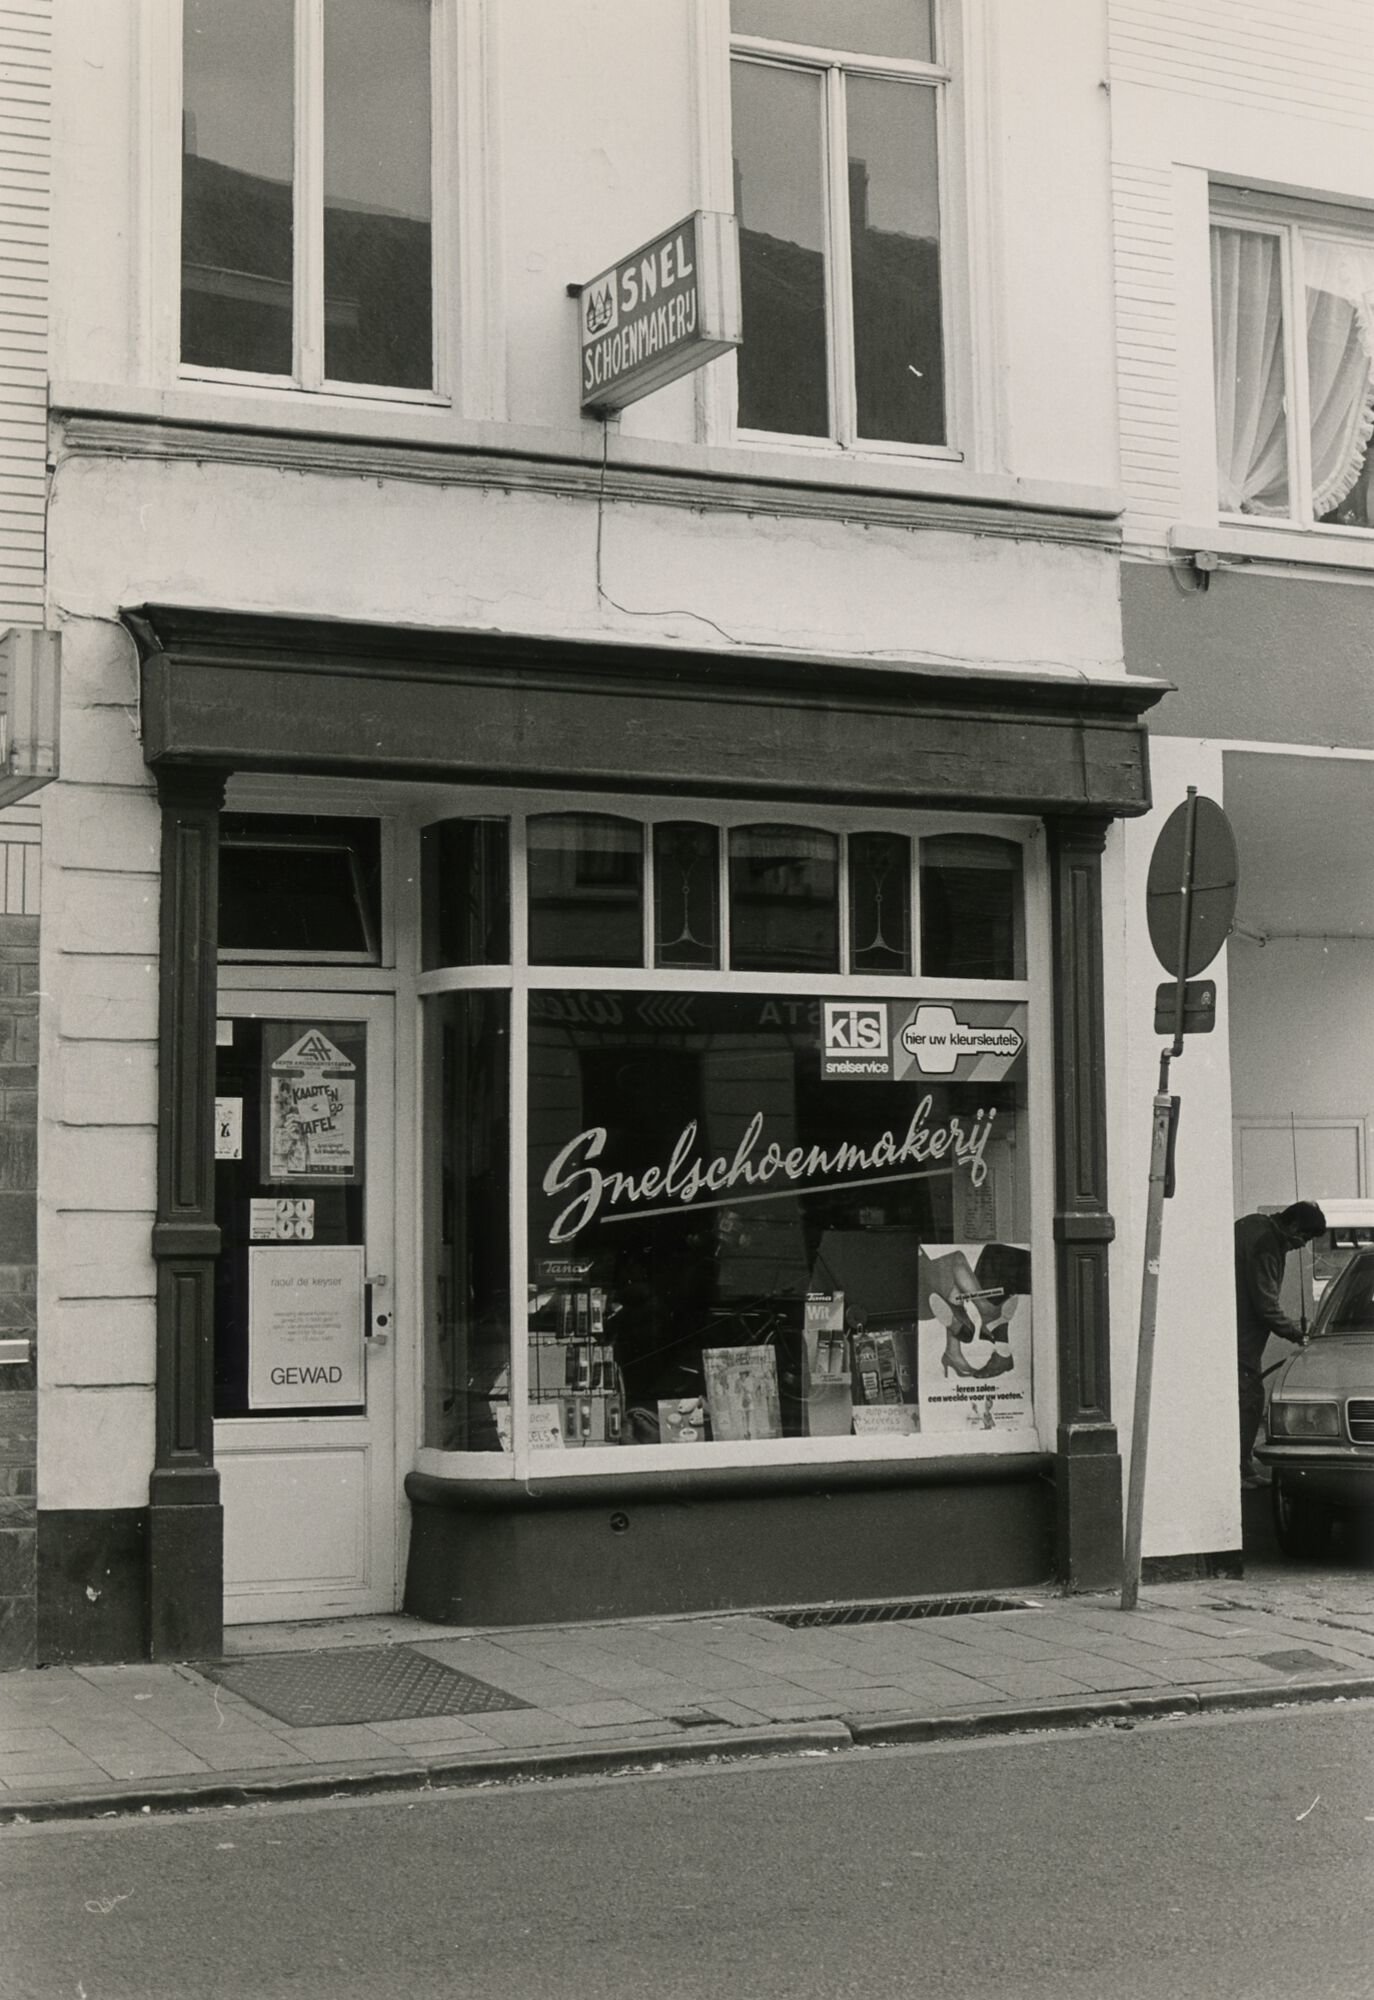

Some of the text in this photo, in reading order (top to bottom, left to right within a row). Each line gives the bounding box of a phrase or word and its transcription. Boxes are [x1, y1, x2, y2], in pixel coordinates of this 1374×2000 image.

[620, 234, 693, 313] SNEL
[584, 287, 697, 390] SCHOENMAKERIJ
[905, 1033, 1018, 1046] hier uw kleursleutels
[825, 1060, 889, 1073] snelservice
[542, 1094, 997, 1244] Snelschoenmakerij
[806, 1305, 830, 1320] Wit
[270, 1366, 343, 1385] GEWAD
